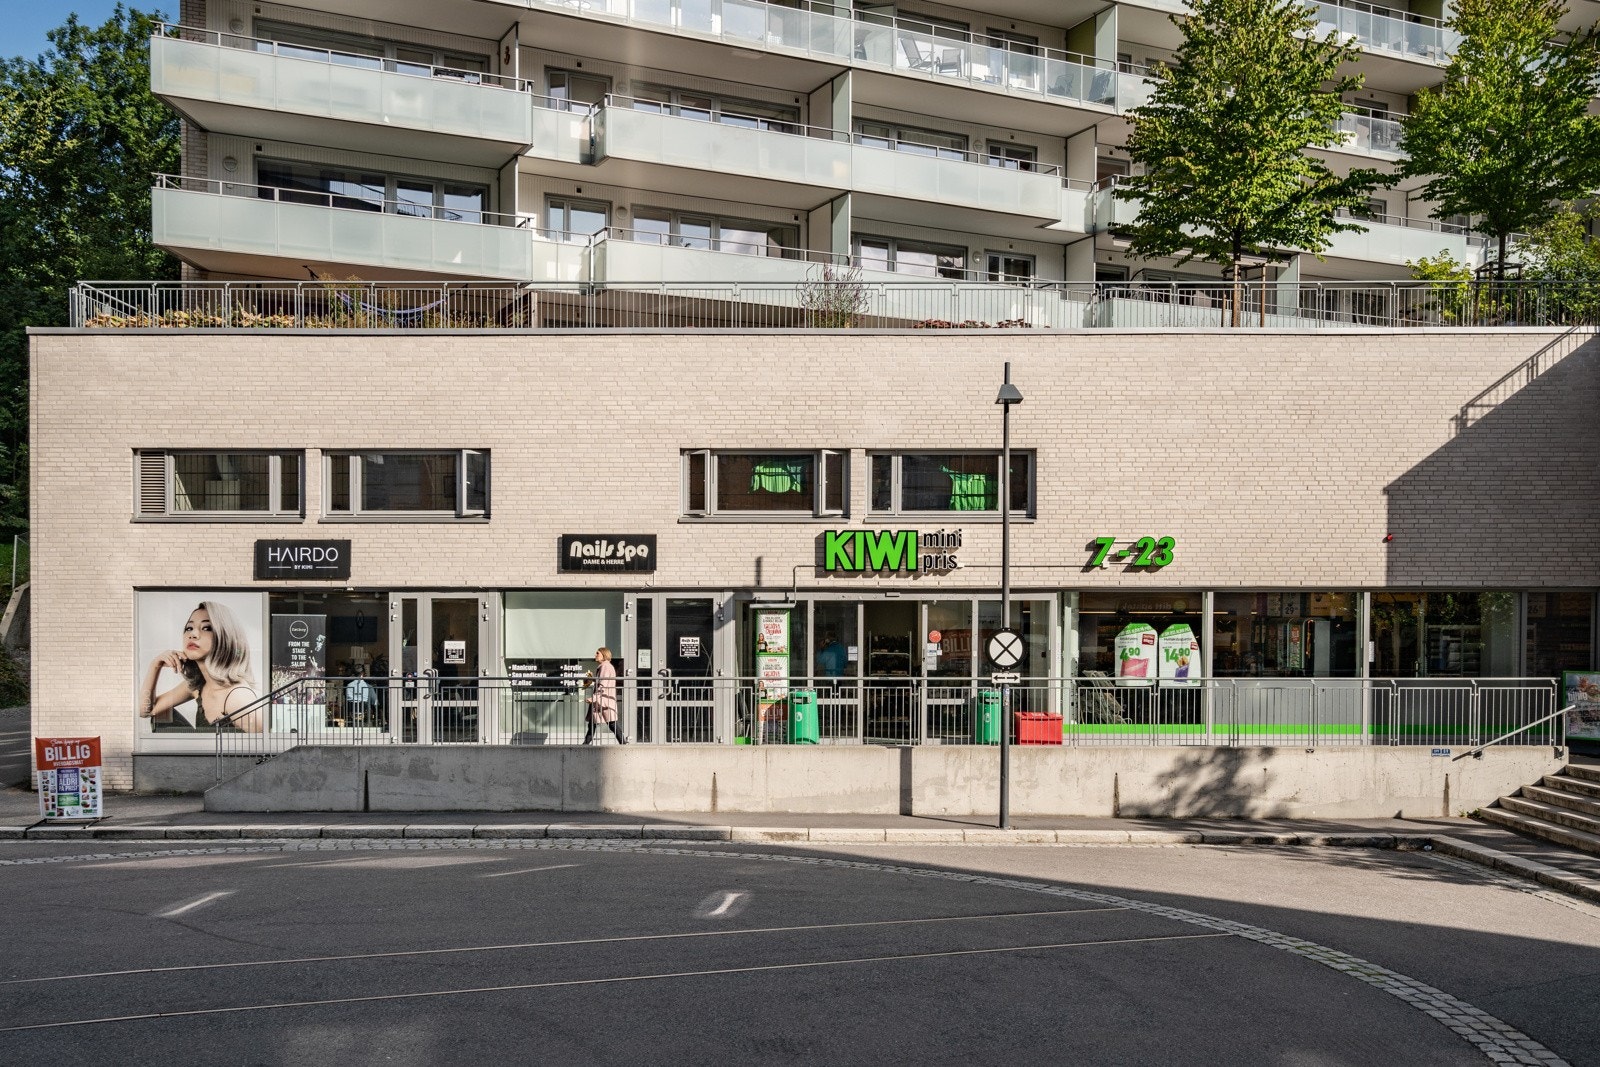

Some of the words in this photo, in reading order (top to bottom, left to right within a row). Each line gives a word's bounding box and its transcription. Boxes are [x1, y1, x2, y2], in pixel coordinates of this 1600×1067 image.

[923, 528, 963, 547] mini
[268, 547, 339, 562] HAIRDO
[569, 539, 615, 558] Nails
[616, 540, 649, 562] Spa
[824, 530, 918, 571] KIWI
[923, 551, 959, 573] pris
[943, 637, 971, 653] BILLI
[45, 744, 90, 761] BILLIG
